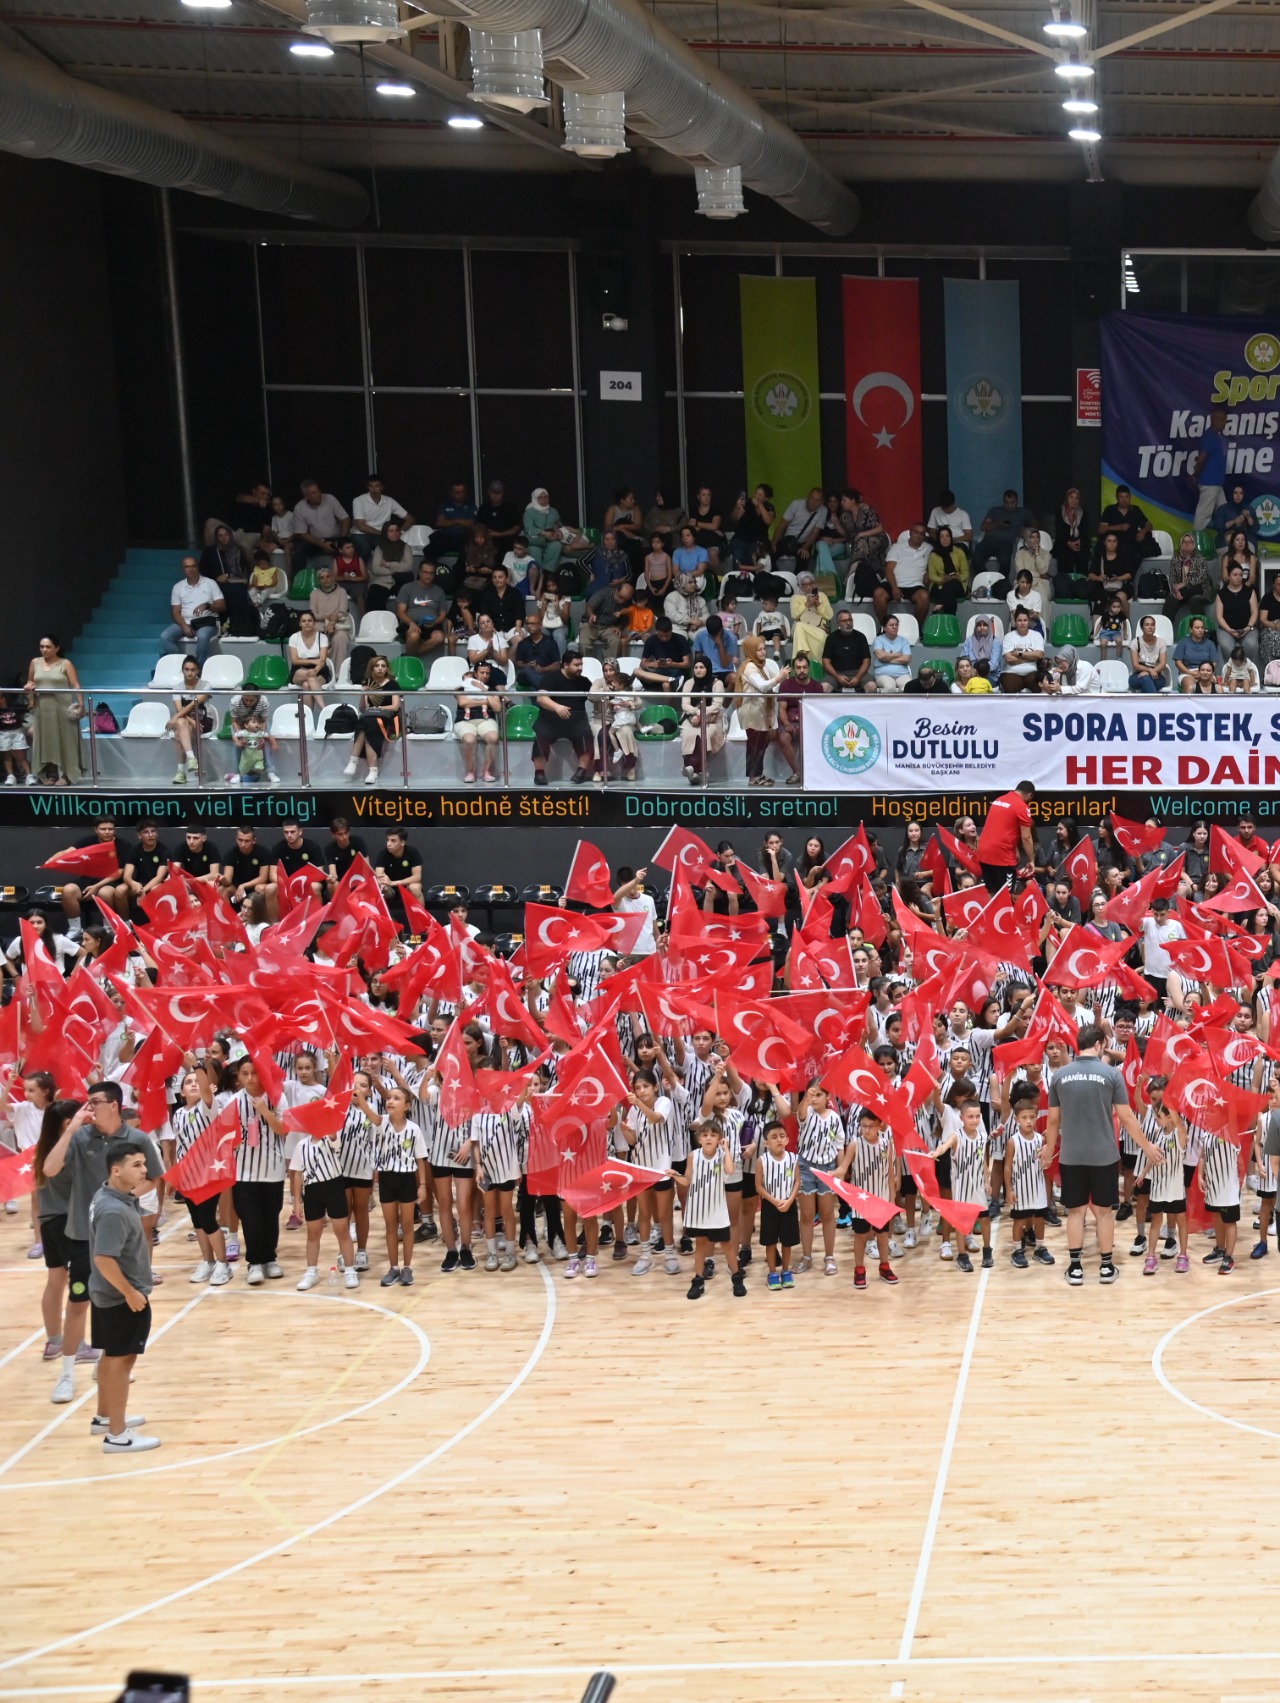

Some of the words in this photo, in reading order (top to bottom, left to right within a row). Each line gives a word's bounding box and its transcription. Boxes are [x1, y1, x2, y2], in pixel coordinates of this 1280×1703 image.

[610, 381, 633, 390] 204
[1138, 442, 1274, 478] Töreine
[913, 717, 978, 738] Besim
[1022, 712, 1129, 742] SPORA
[1136, 712, 1262, 746] DESTEK,
[892, 739, 999, 760] DUTLULU
[922, 761, 963, 770] BÜYÜKŞEHİR
[964, 761, 996, 769] BELEDİYE
[1066, 755, 1162, 785] HER
[31, 796, 186, 818] Willkommen,
[194, 796, 232, 816] viel
[242, 795, 317, 822] Erfolg!
[353, 795, 433, 821] Vítejte,
[441, 796, 511, 816] hodně
[519, 795, 589, 816] štěstí!
[625, 795, 752, 818] Dobrodošli,
[760, 796, 838, 816] sretno!
[872, 795, 988, 822] Hoşgeldini
[1027, 796, 1115, 822] aşarılar!
[1151, 796, 1251, 816] Welcome
[1061, 1072, 1088, 1084] MANİSA
[1088, 1073, 1106, 1085] BBSK
